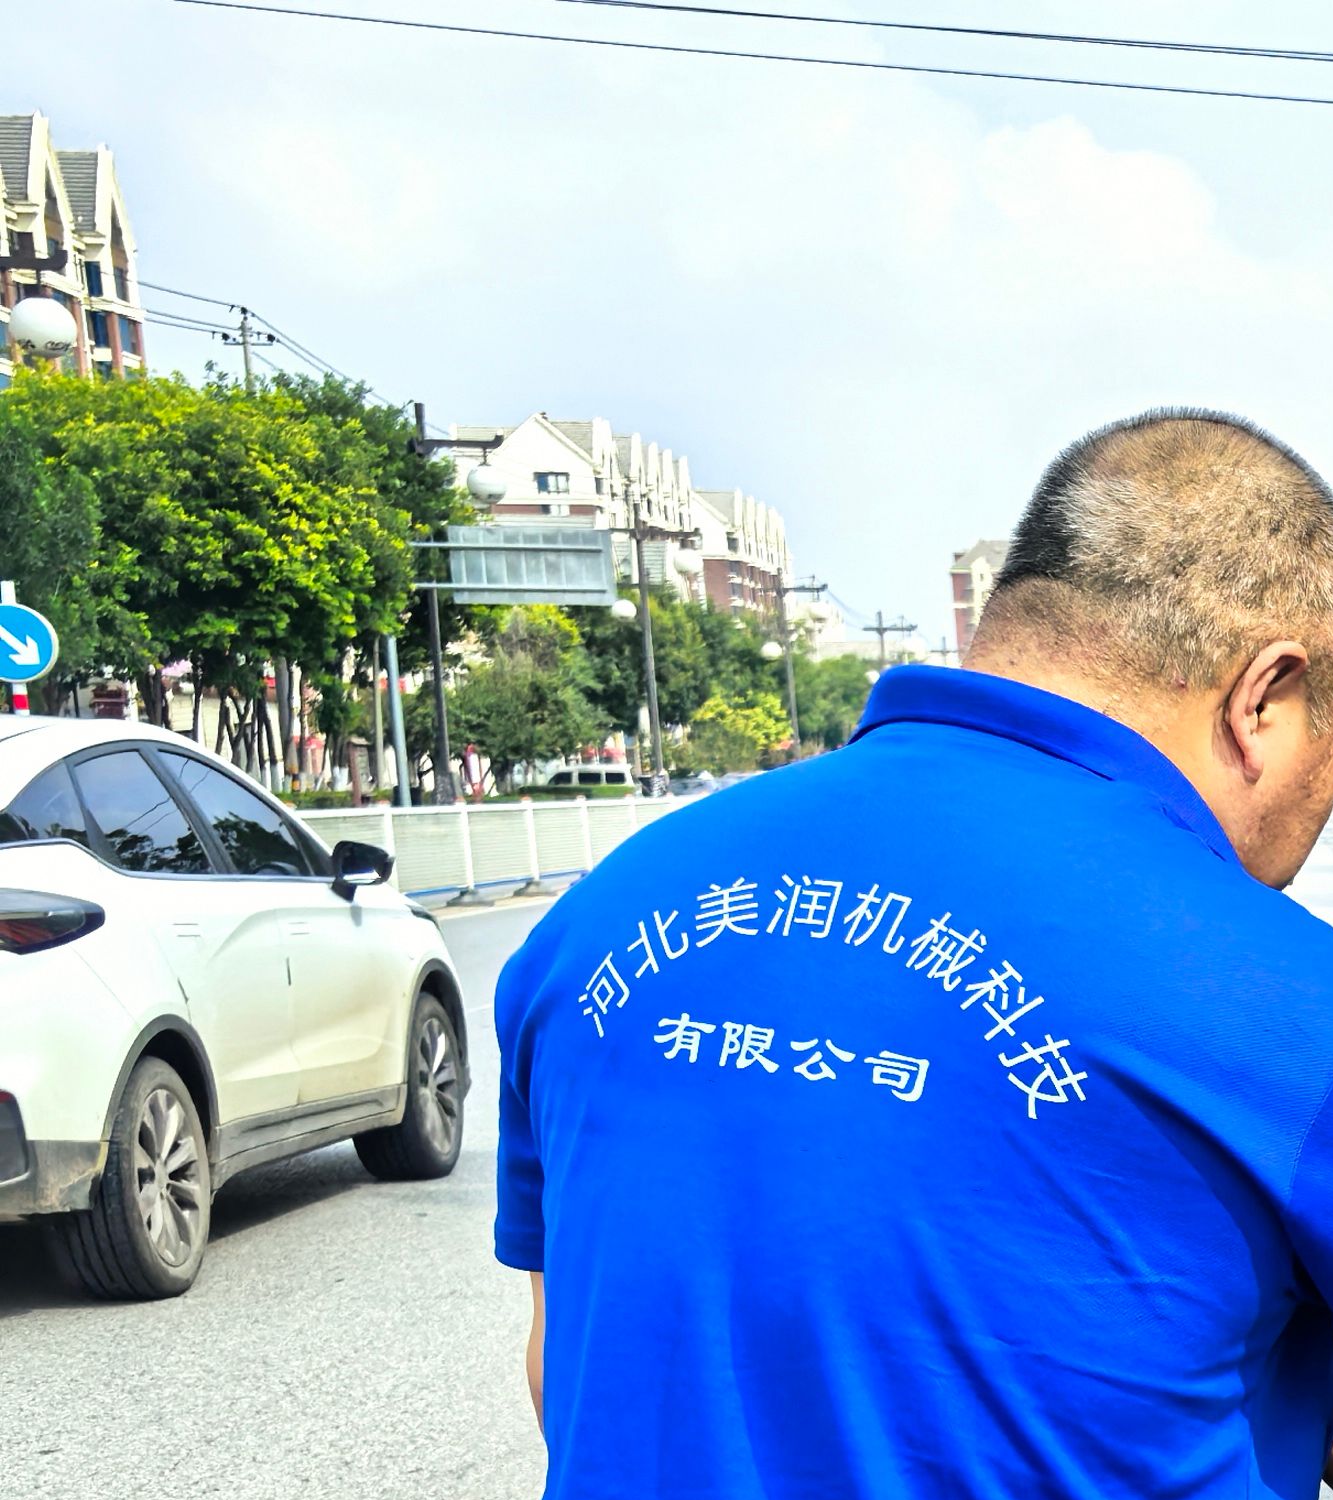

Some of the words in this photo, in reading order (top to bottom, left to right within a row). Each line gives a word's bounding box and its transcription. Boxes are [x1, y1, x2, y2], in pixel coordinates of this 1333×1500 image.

[577, 873, 1088, 1120] 河北美润机械科技
[653, 1012, 931, 1102] 有限公司
